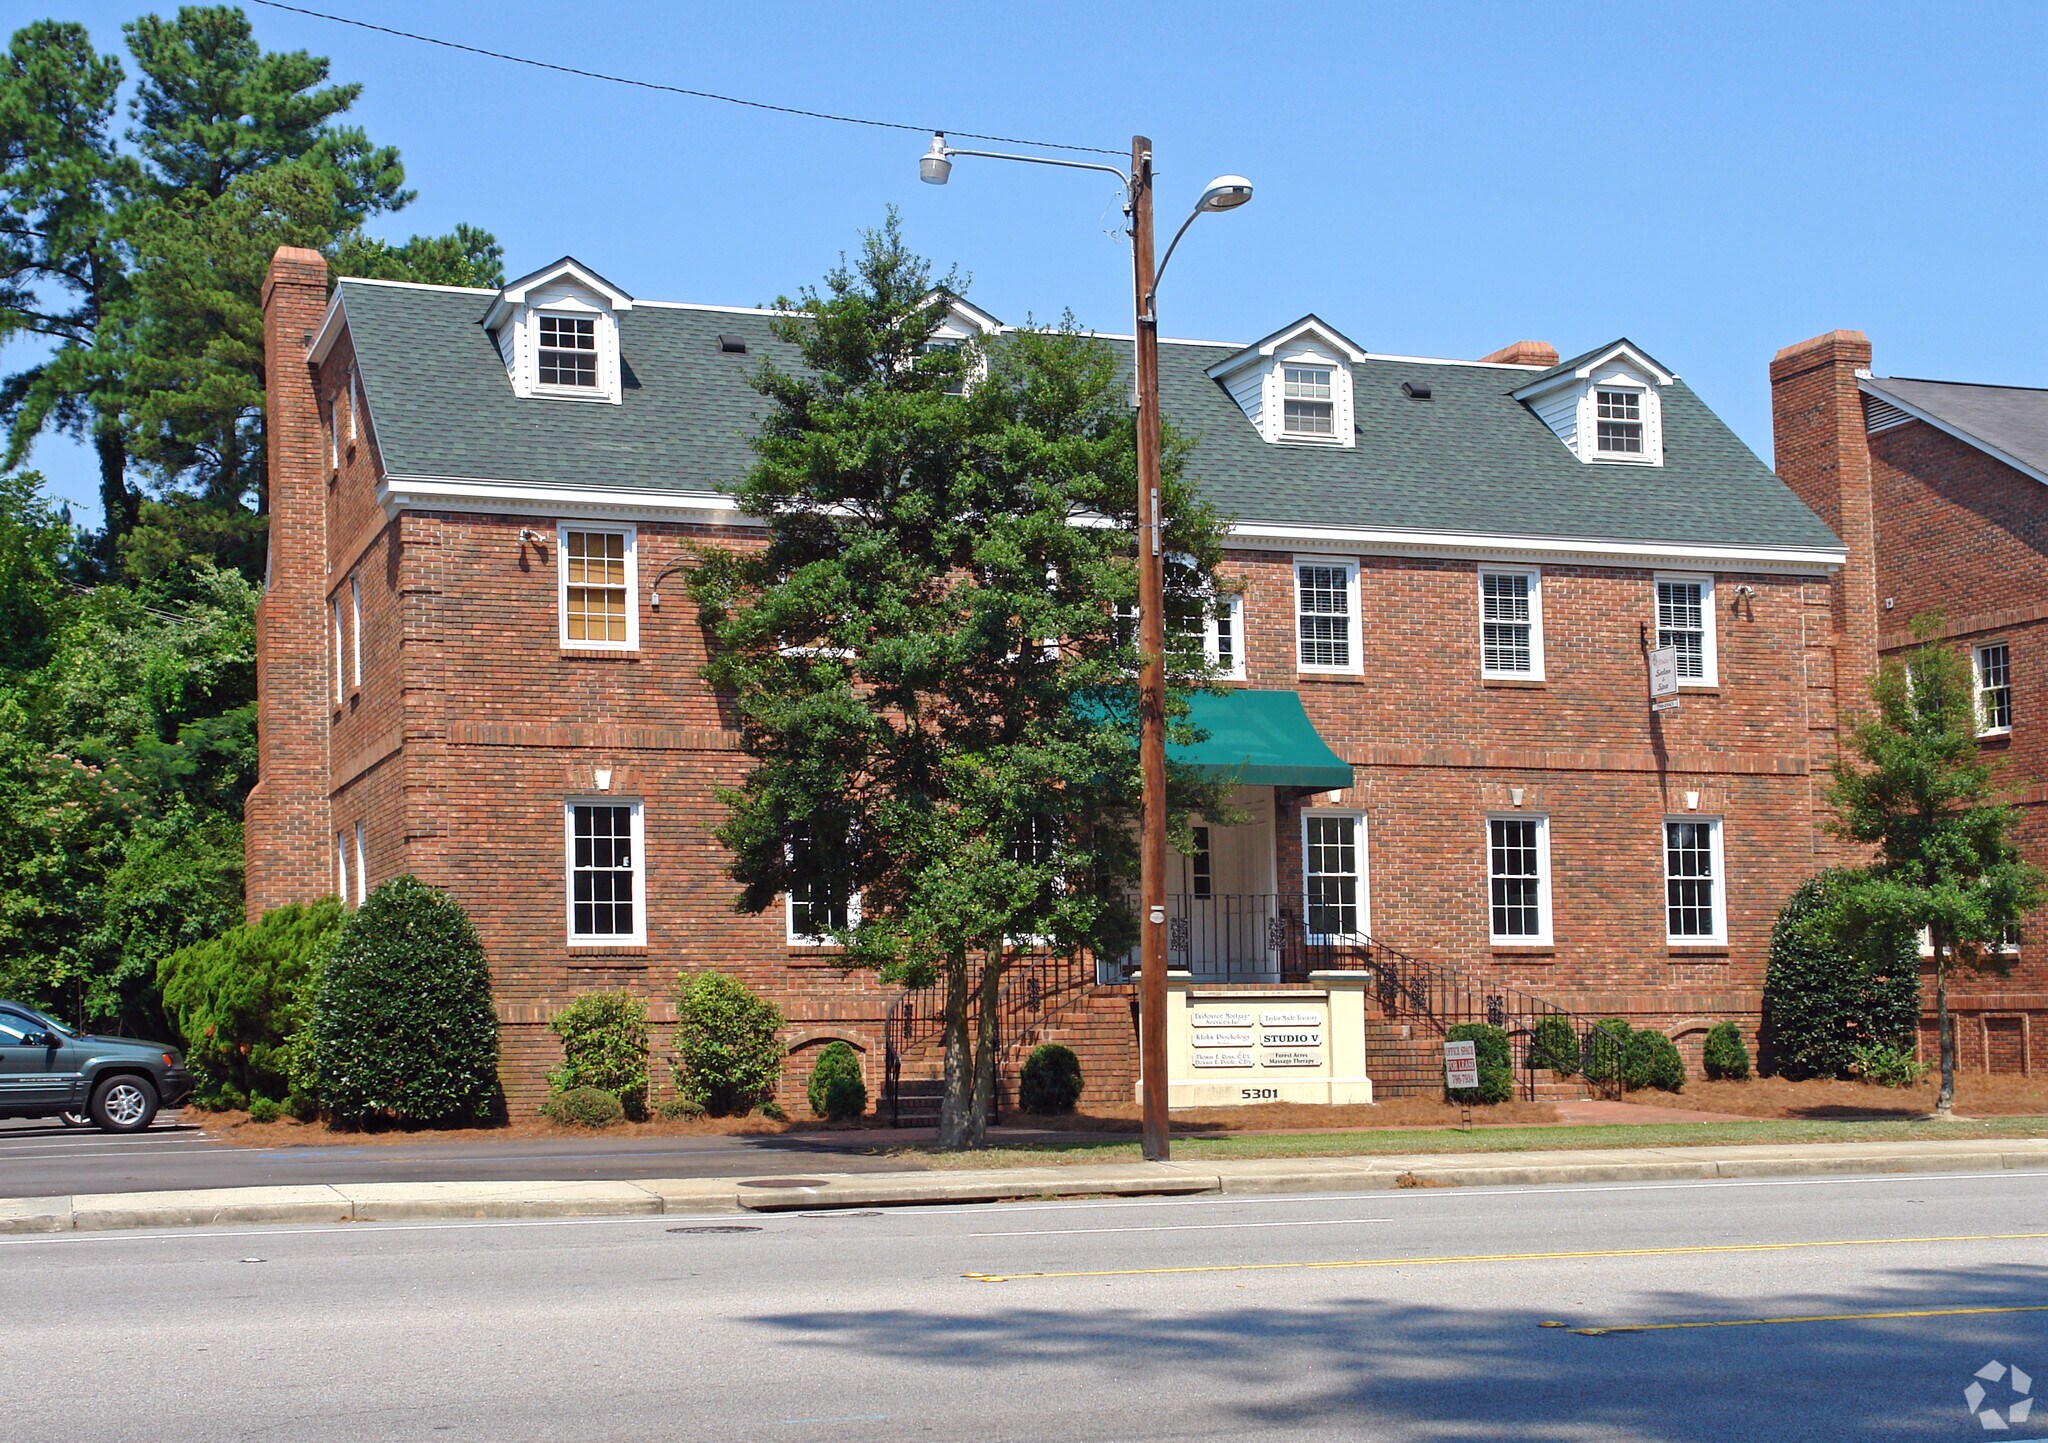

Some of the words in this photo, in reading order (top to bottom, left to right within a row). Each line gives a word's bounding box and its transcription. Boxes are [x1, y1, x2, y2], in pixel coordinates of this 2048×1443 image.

[1655, 667, 1671, 678] Salon
[1657, 683, 1669, 692] Spa
[1263, 1034, 1308, 1043] STUDIO
[1311, 1034, 1319, 1042] V
[1446, 1047, 1460, 1056] OFFICE
[1460, 1045, 1474, 1055] SPACE
[1447, 1060, 1458, 1071] FOR
[1458, 1059, 1475, 1070] LEASE
[1241, 1088, 1278, 1099] 5301
